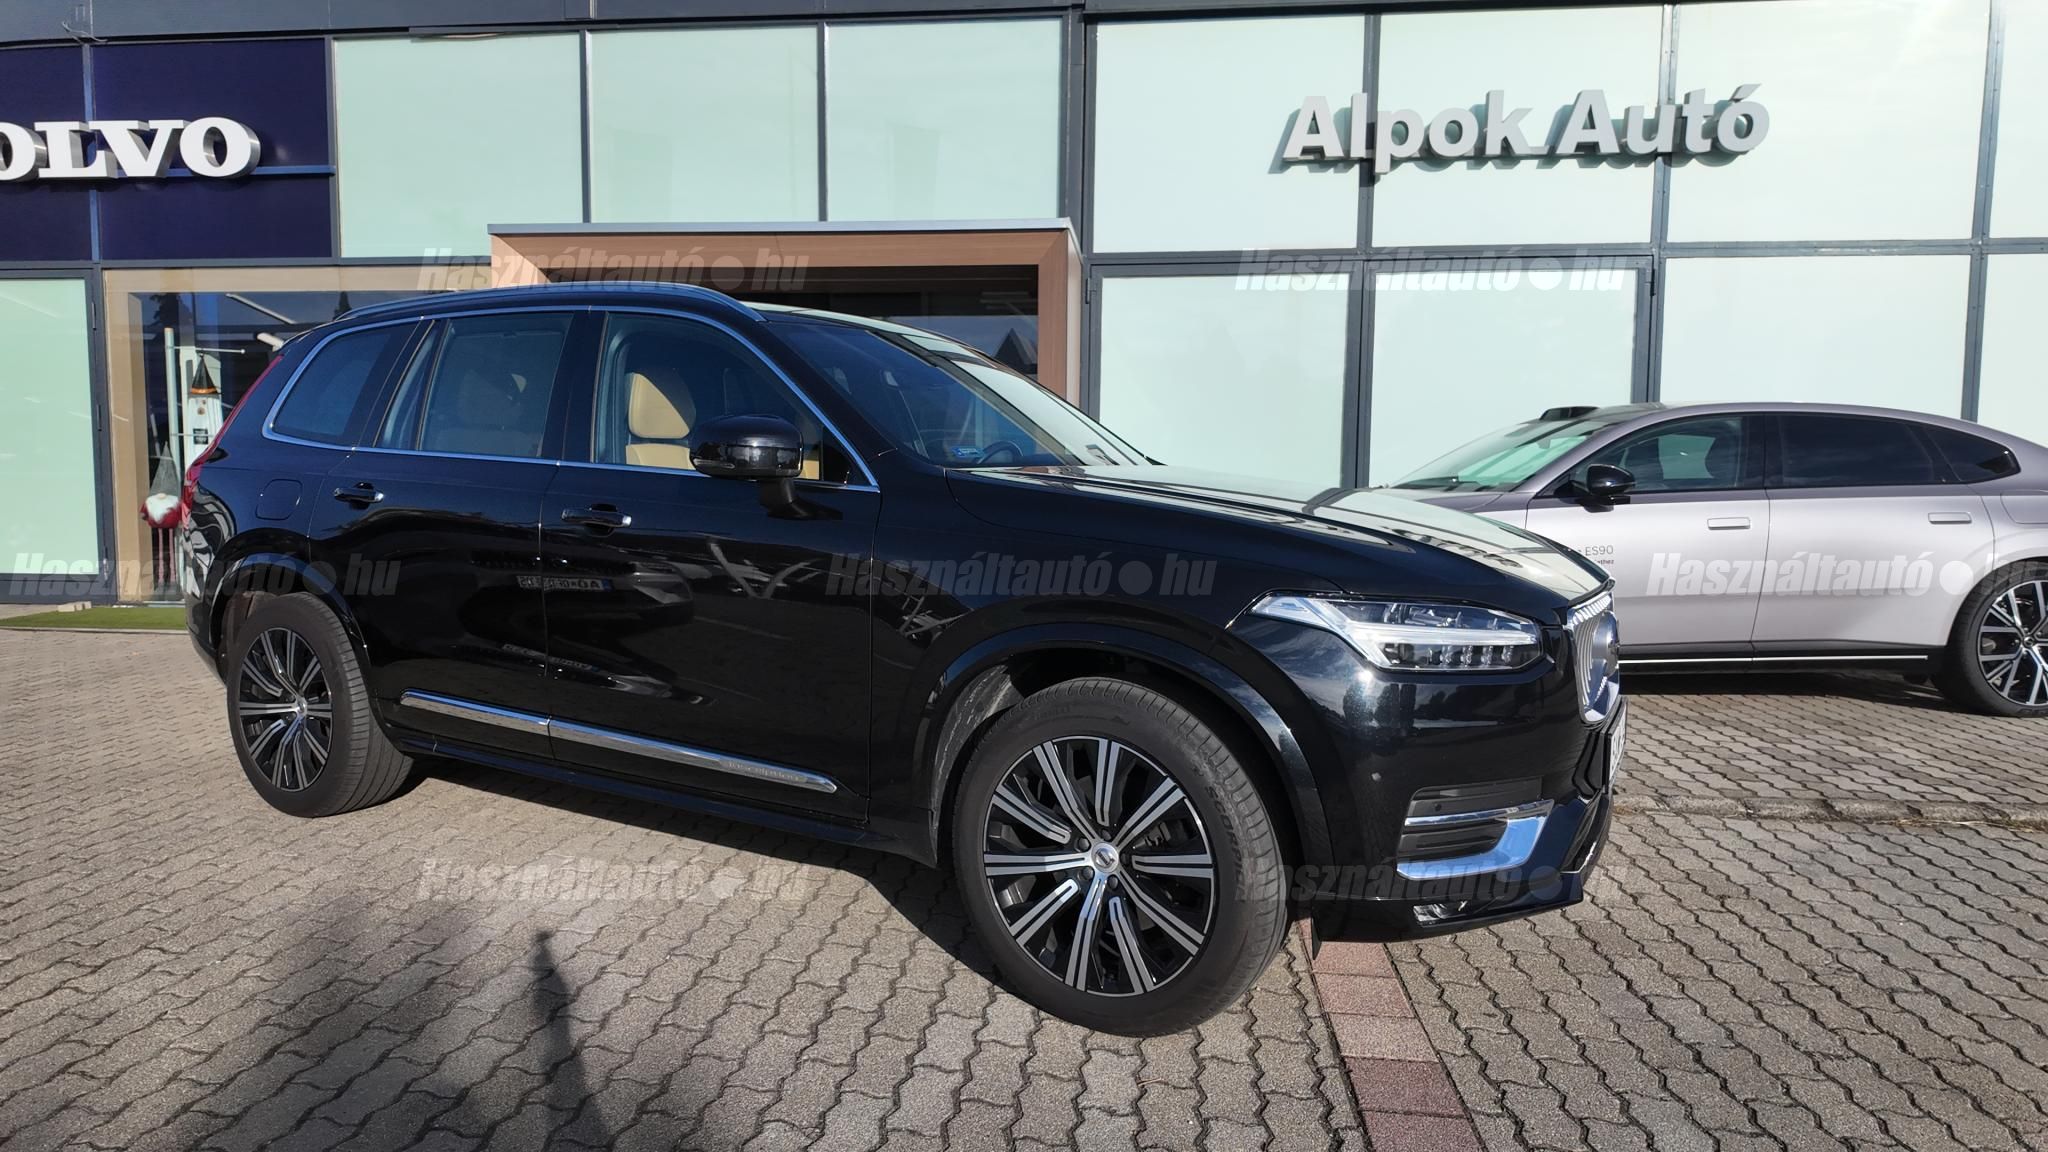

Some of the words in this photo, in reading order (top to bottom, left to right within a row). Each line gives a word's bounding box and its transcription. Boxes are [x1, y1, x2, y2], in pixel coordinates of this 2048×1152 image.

[1283, 90, 1533, 175] Alpok
[1556, 83, 1770, 156] Autó
[1585, 545, 1614, 556] ES90
